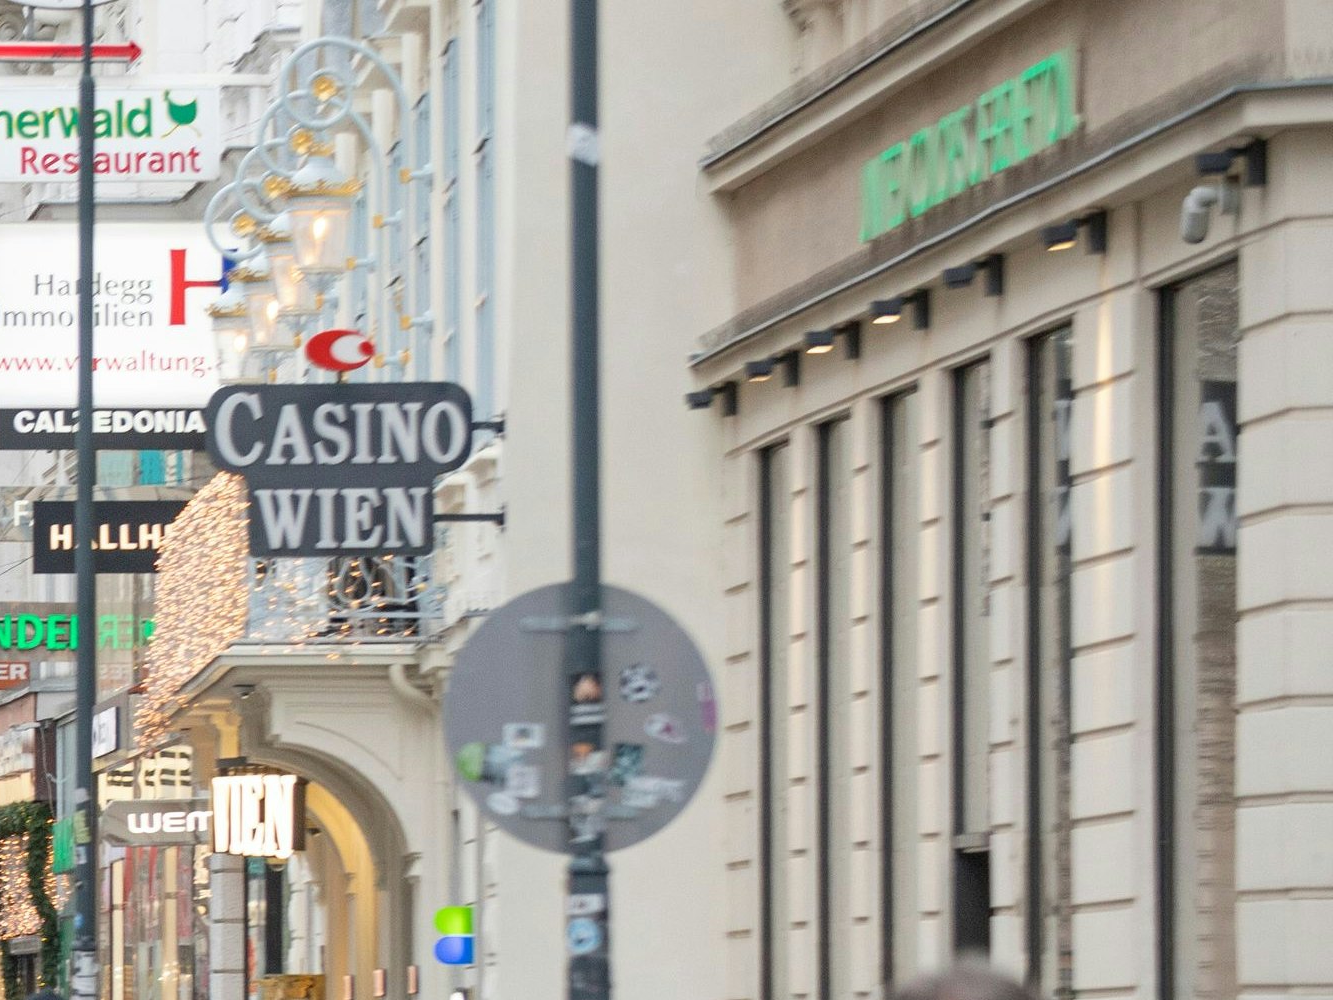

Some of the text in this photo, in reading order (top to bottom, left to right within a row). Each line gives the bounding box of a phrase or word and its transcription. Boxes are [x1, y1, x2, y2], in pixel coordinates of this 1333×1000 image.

[20, 146, 201, 174] Resaurant
[214, 391, 468, 467] CASINO
[49, 523, 175, 550] HLLH
[254, 487, 430, 550] WIEN
